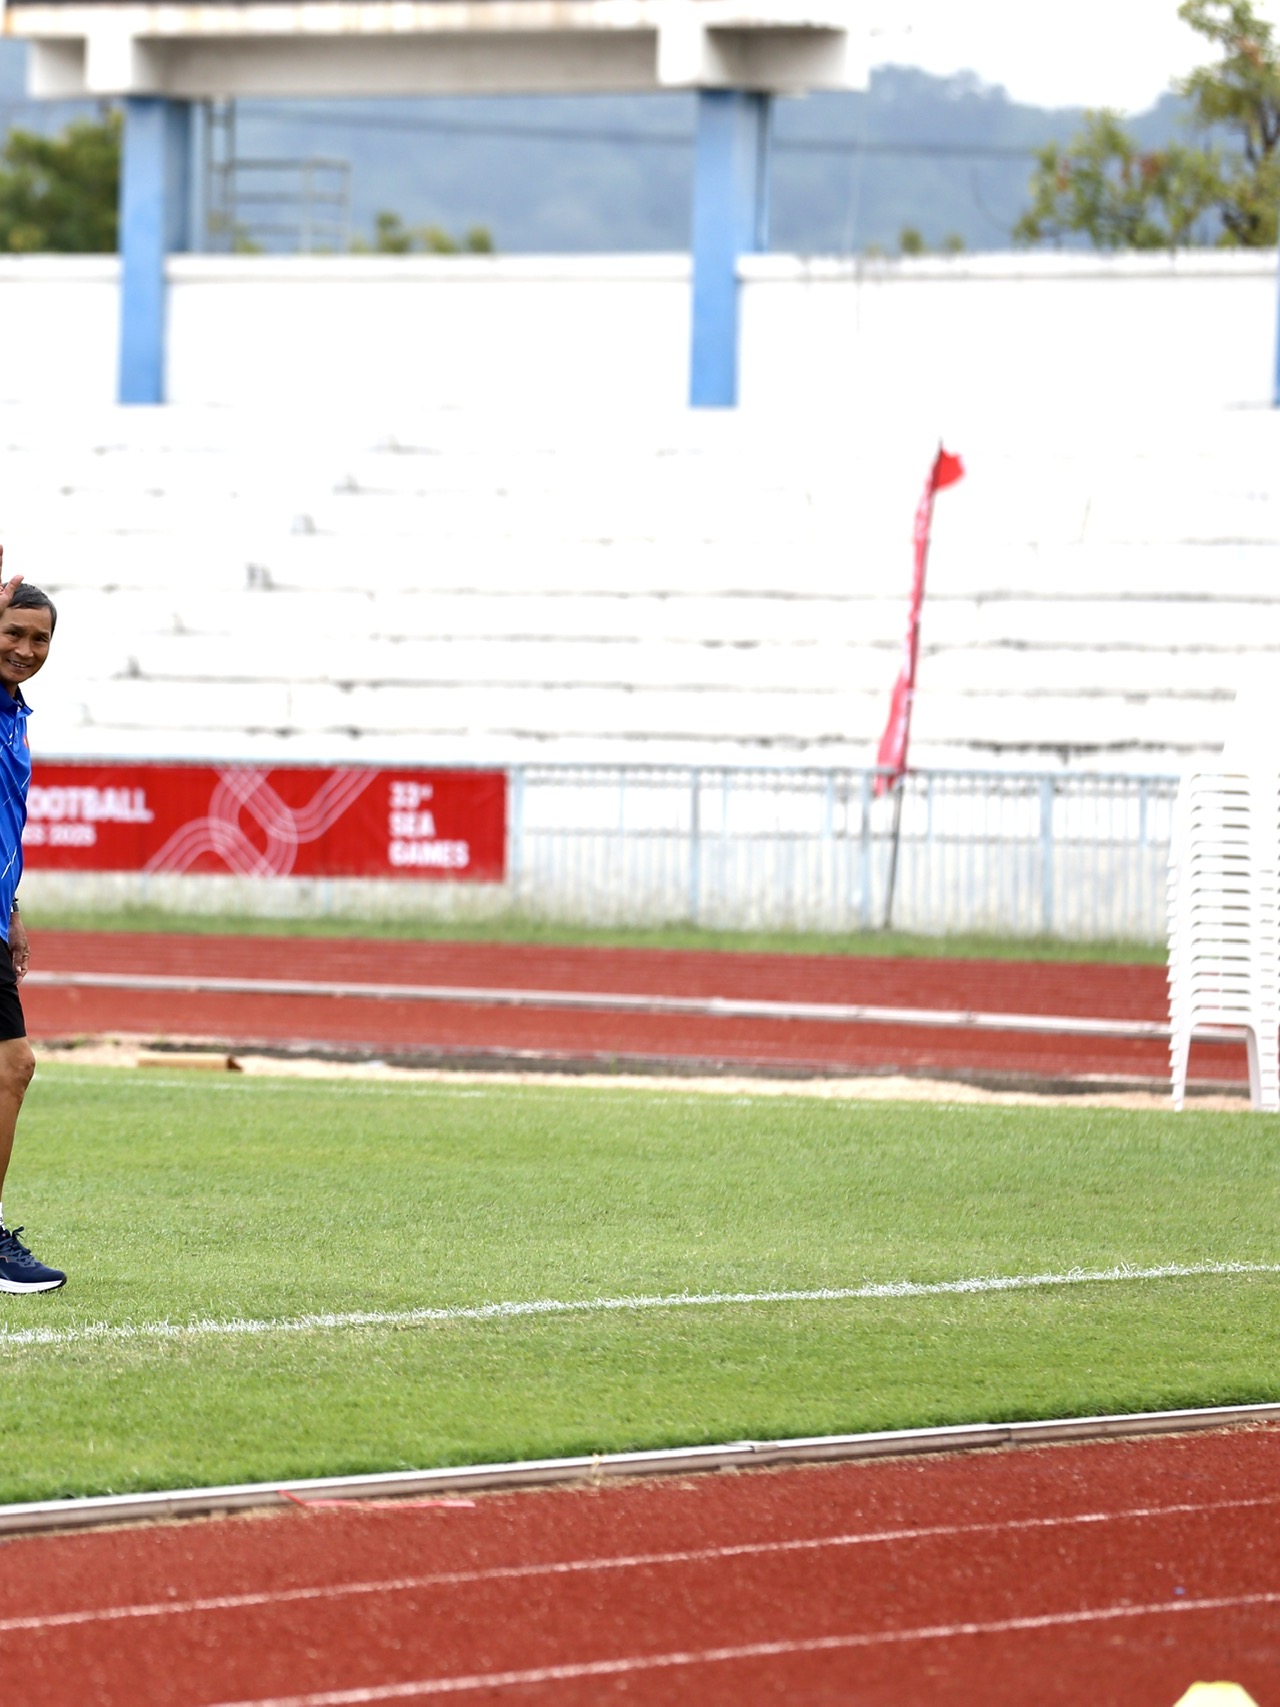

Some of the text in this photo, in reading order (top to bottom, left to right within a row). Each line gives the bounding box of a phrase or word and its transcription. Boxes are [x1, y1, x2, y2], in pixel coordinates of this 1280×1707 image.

[26, 785, 154, 822] OOTBALL
[389, 809, 436, 838] SEA
[388, 839, 469, 869] GAMES
